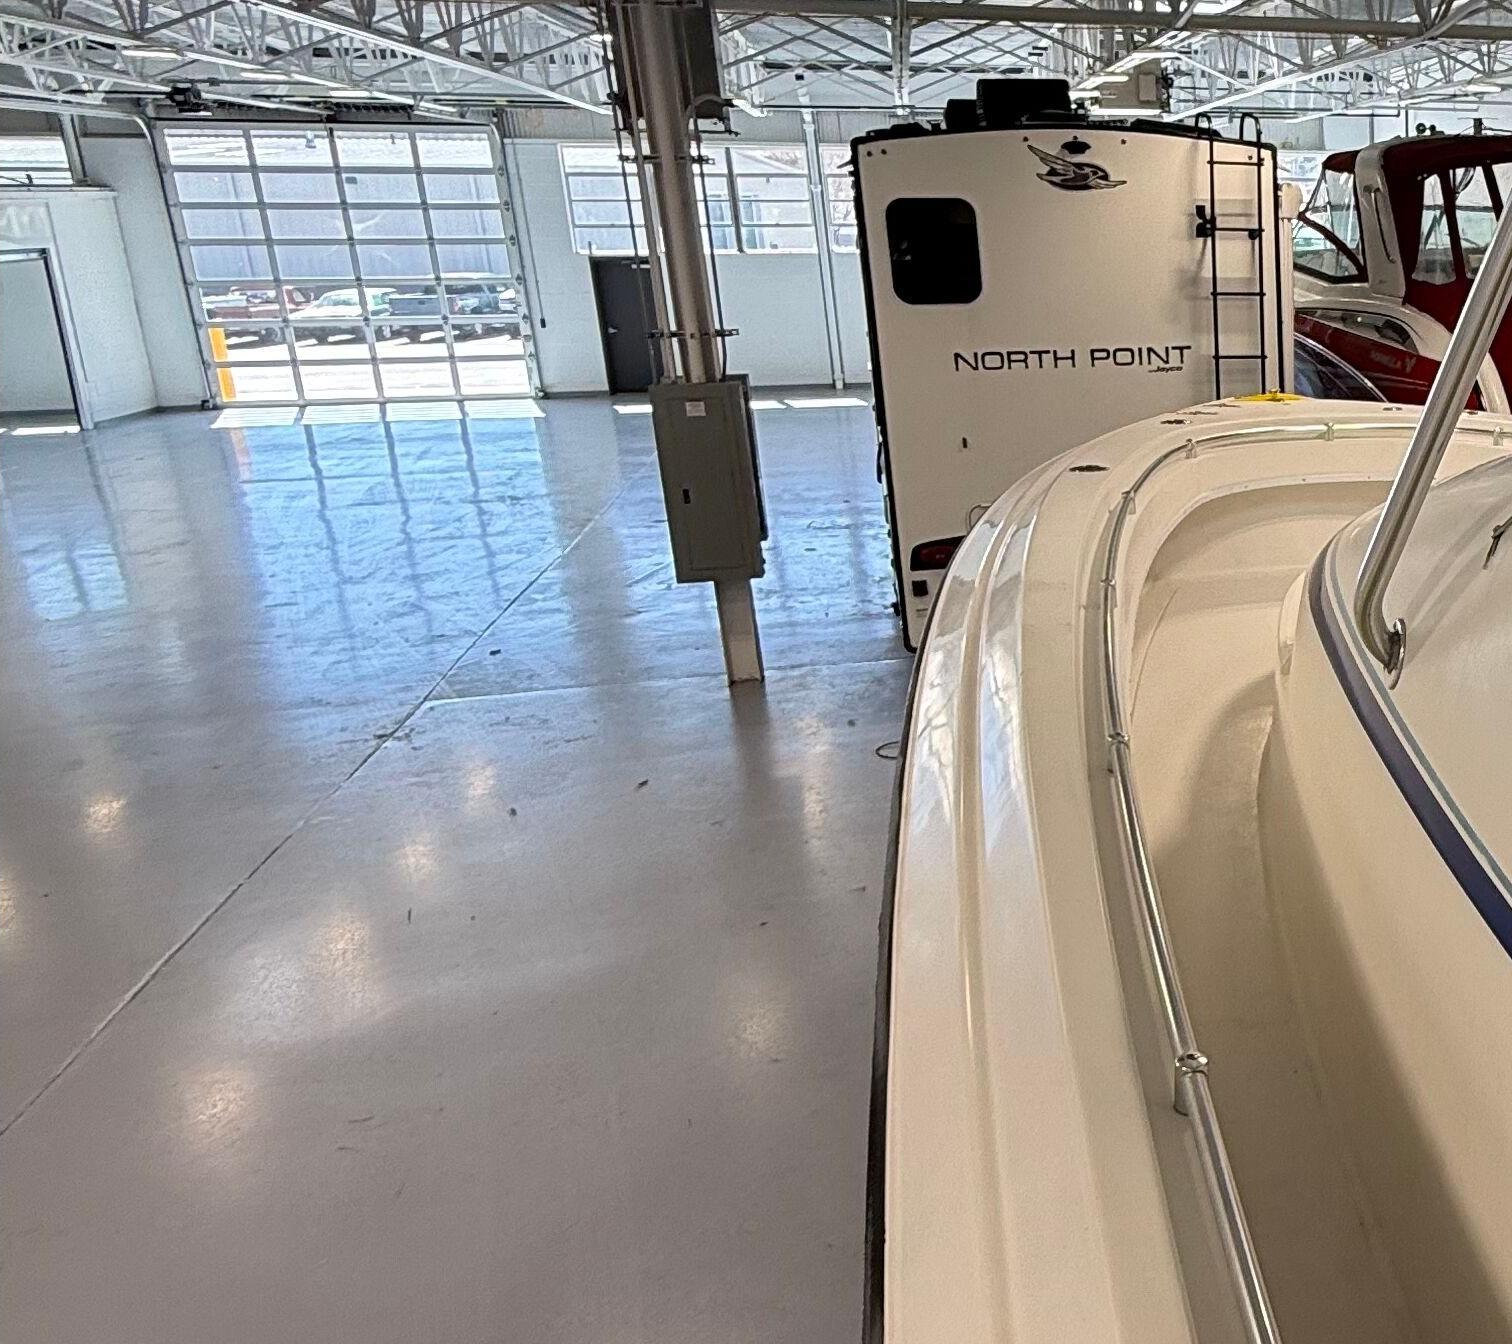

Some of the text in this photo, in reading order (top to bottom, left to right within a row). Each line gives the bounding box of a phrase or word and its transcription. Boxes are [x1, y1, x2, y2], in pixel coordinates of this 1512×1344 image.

[953, 345, 1192, 372] NORTH POINT
[1149, 365, 1183, 374] Jayco
